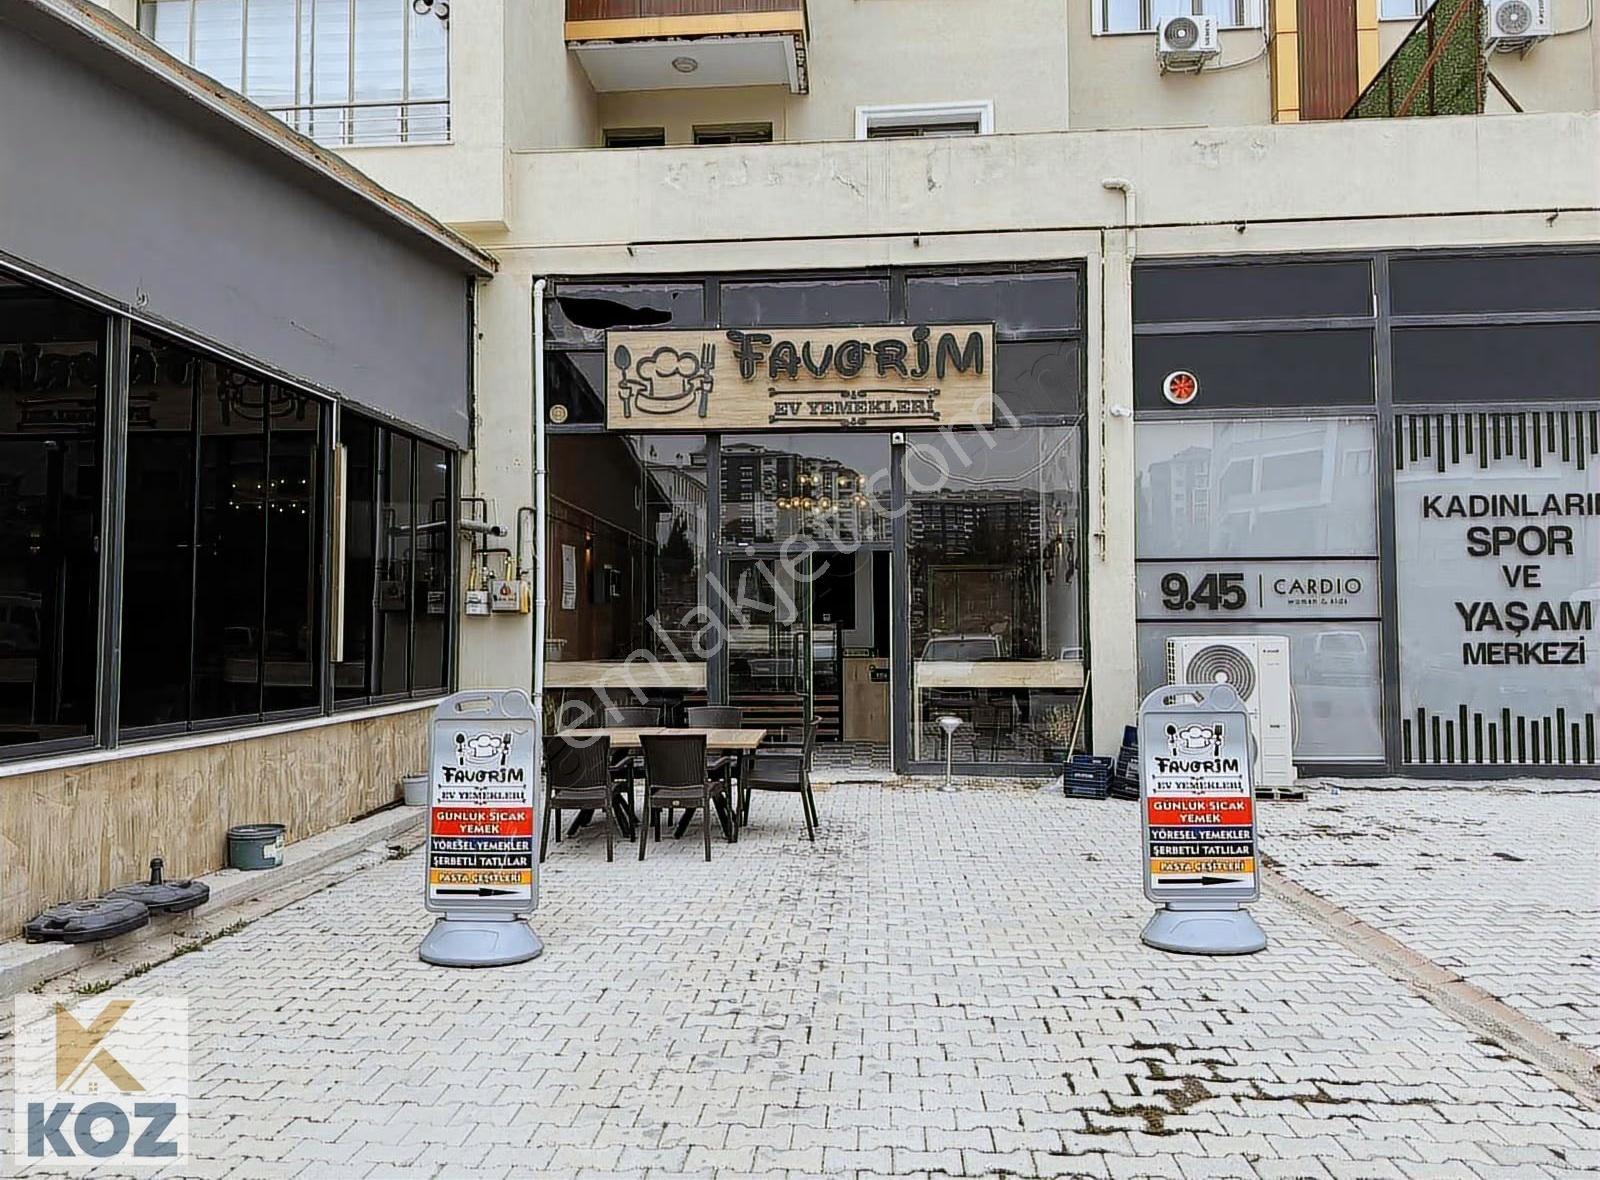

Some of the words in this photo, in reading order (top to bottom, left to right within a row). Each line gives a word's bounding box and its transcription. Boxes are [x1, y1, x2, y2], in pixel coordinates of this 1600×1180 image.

[774, 400, 803, 416] EV
[807, 395, 935, 416] YEMEKLERİ
[1423, 493, 1600, 518] KADINLARI
[1467, 525, 1574, 557] SPOR
[1502, 565, 1541, 588] VE
[1161, 573, 1247, 611] 9.45
[1273, 578, 1362, 595] CARDIO
[1455, 601, 1592, 638] YAŞAM
[1463, 636, 1586, 665] MERKEZİ
[1209, 801, 1245, 811] SICAK
[460, 824, 500, 833] YEMEK
[1180, 813, 1221, 823] YEMEK
[1199, 830, 1250, 840] YEMEKLER
[477, 841, 529, 851] YEMEKLER
[1201, 845, 1249, 855] TATLILAR
